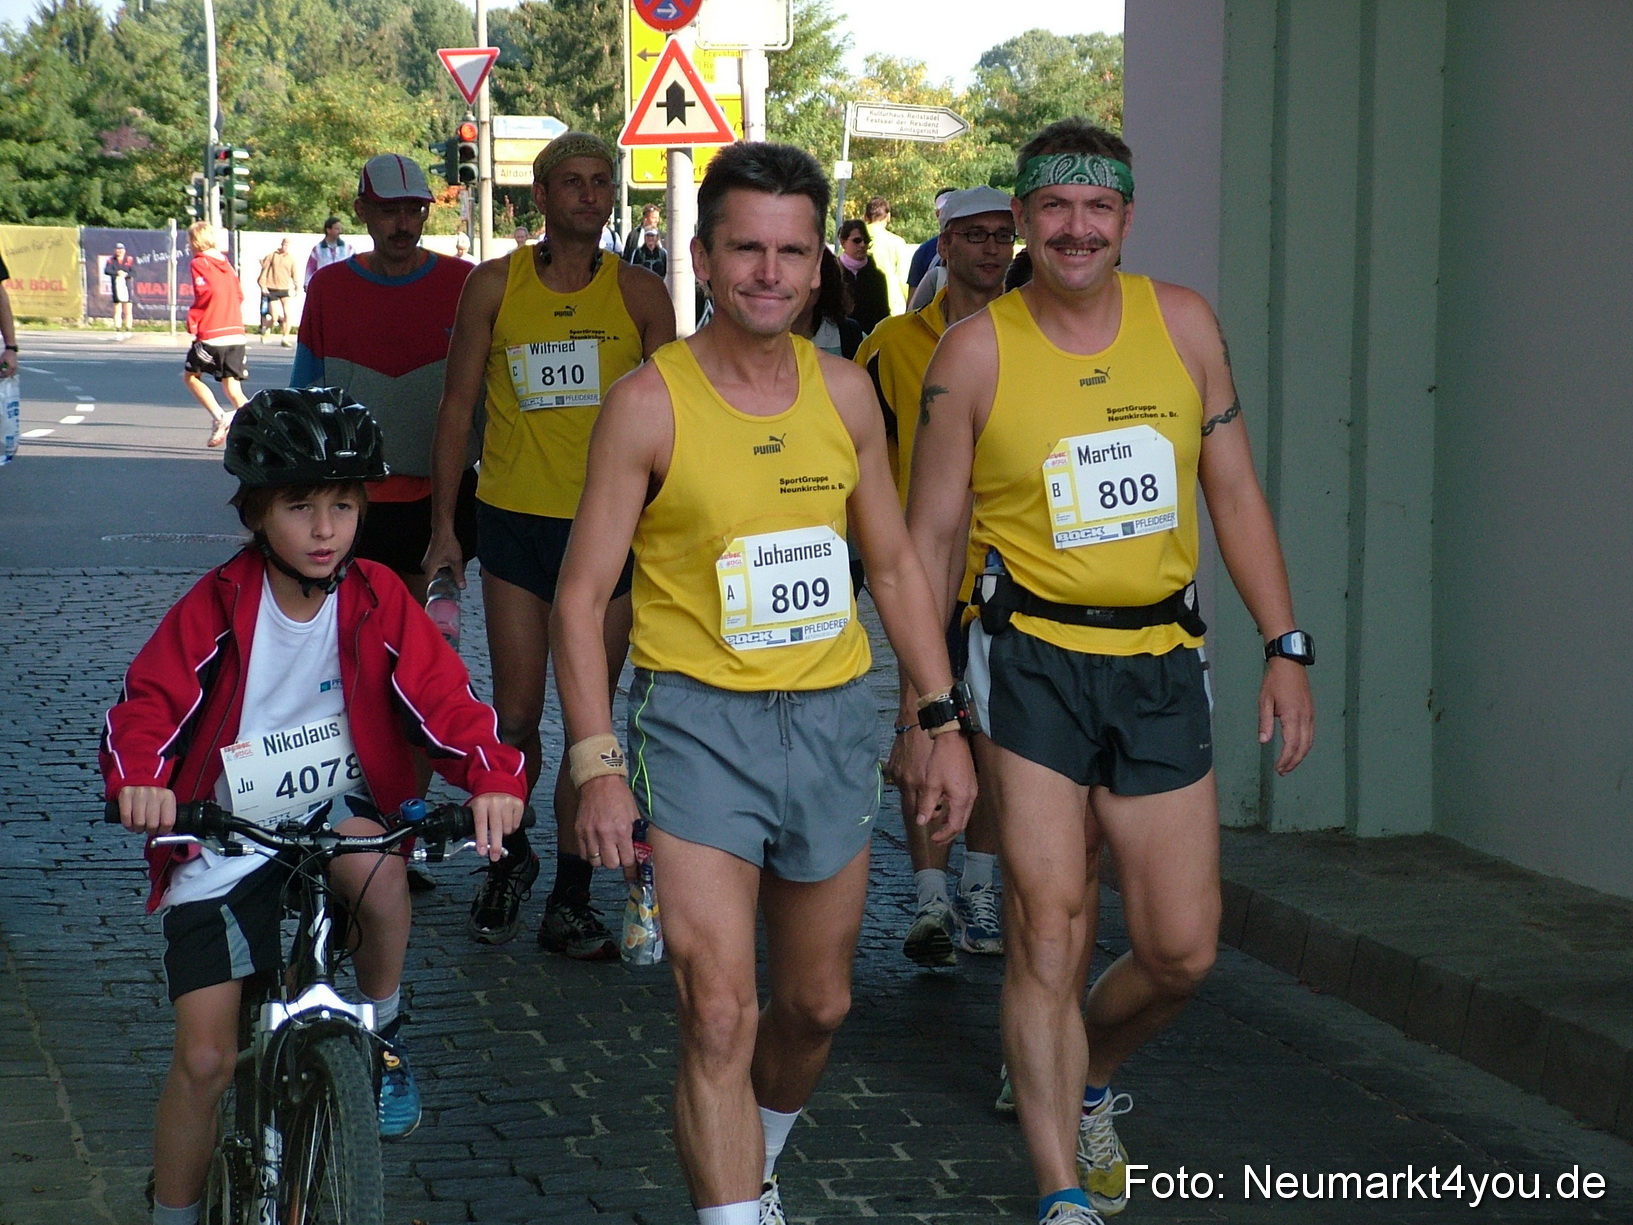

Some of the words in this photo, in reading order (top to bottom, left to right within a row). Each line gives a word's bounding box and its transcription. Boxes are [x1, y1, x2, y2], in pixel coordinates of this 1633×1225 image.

[5, 279, 24, 290] AX
[530, 341, 576, 355] Wilfried
[512, 366, 518, 377] C
[541, 364, 585, 386] 810
[1080, 375, 1106, 387] PUMA
[1106, 405, 1157, 415] SportGruppe
[1108, 412, 1159, 422] Neunkirchen
[753, 443, 781, 455] PUMA
[1077, 442, 1133, 466] Martin
[779, 476, 829, 486] SportGruppe
[780, 485, 830, 494] Neunkirchen
[1052, 482, 1061, 498] B
[1098, 473, 1159, 509] 808
[1056, 526, 1105, 543] BOCK
[1135, 512, 1176, 529] PFLEIDERER
[753, 542, 832, 567] Johannes
[727, 585, 735, 600] A
[772, 577, 830, 613] 809
[804, 617, 848, 635] PFLEIDERER
[262, 722, 341, 757] Nikolaus
[276, 752, 361, 799] 4078
[238, 777, 254, 794] Ju
